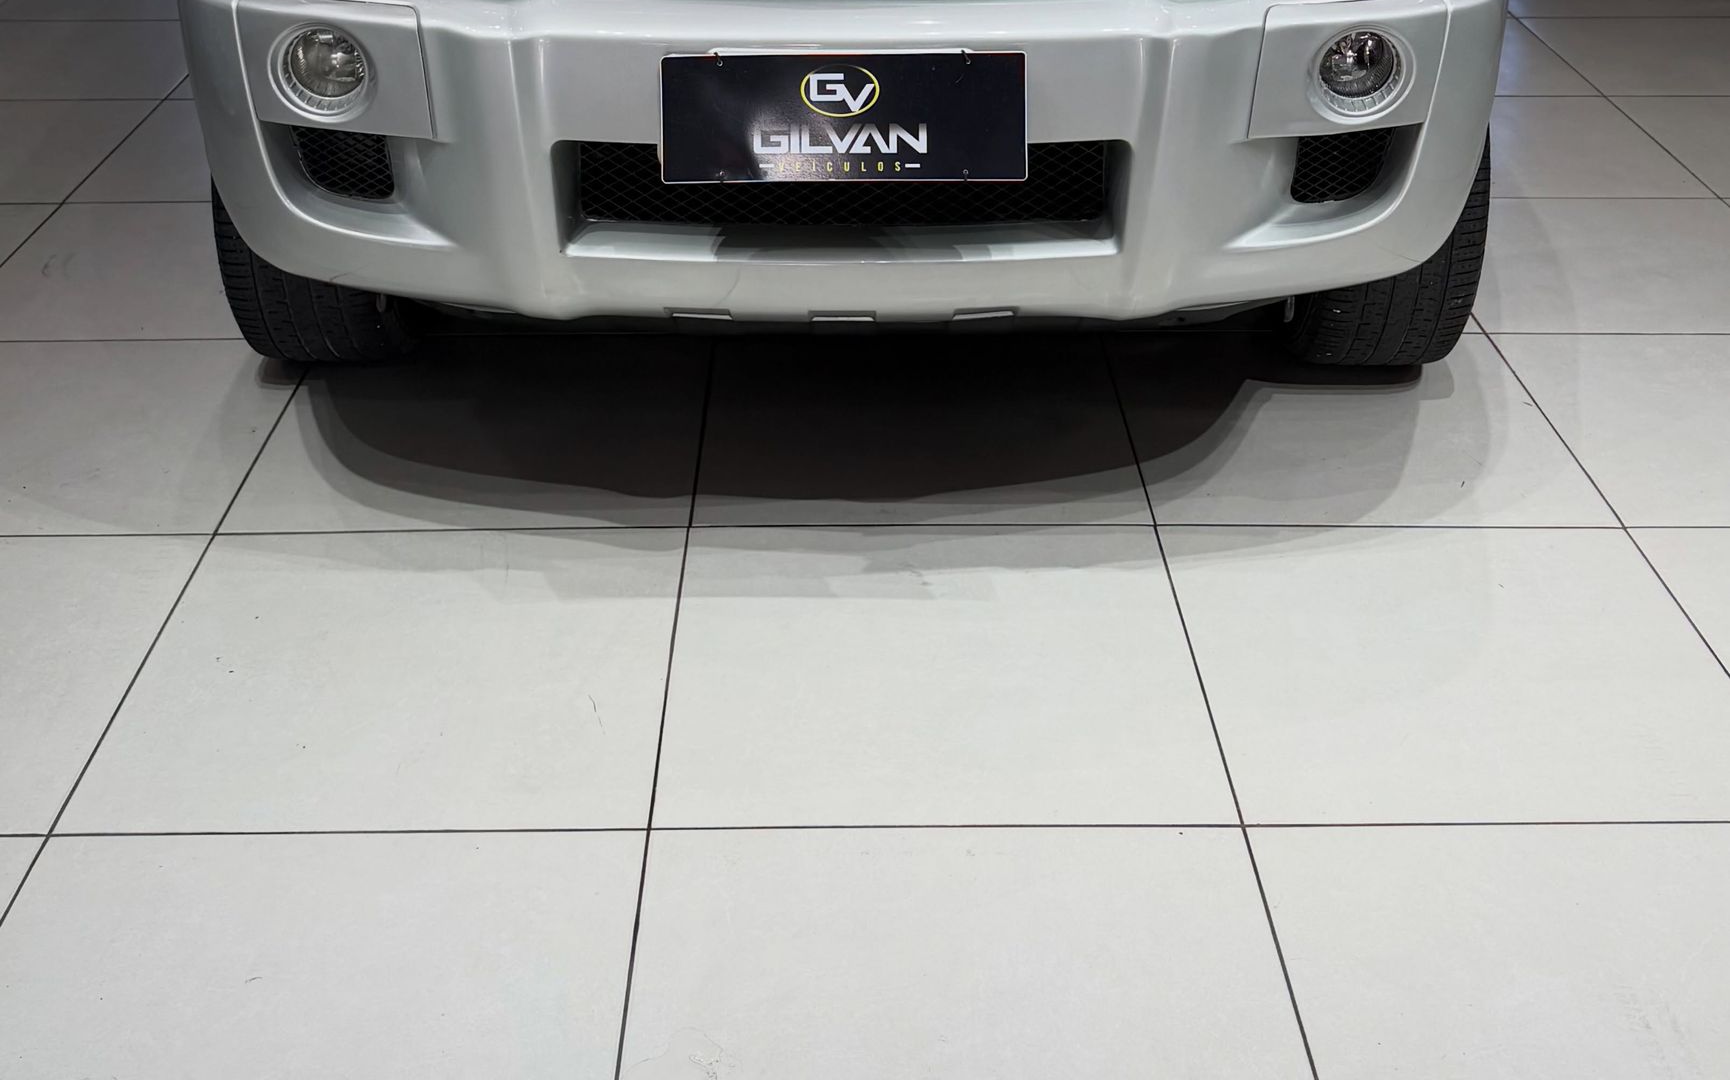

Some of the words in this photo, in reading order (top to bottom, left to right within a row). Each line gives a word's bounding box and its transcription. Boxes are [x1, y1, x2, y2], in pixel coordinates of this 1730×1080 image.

[809, 73, 875, 112] GV
[753, 123, 928, 154] GILVAN
[778, 161, 902, 172] VEICULOS
